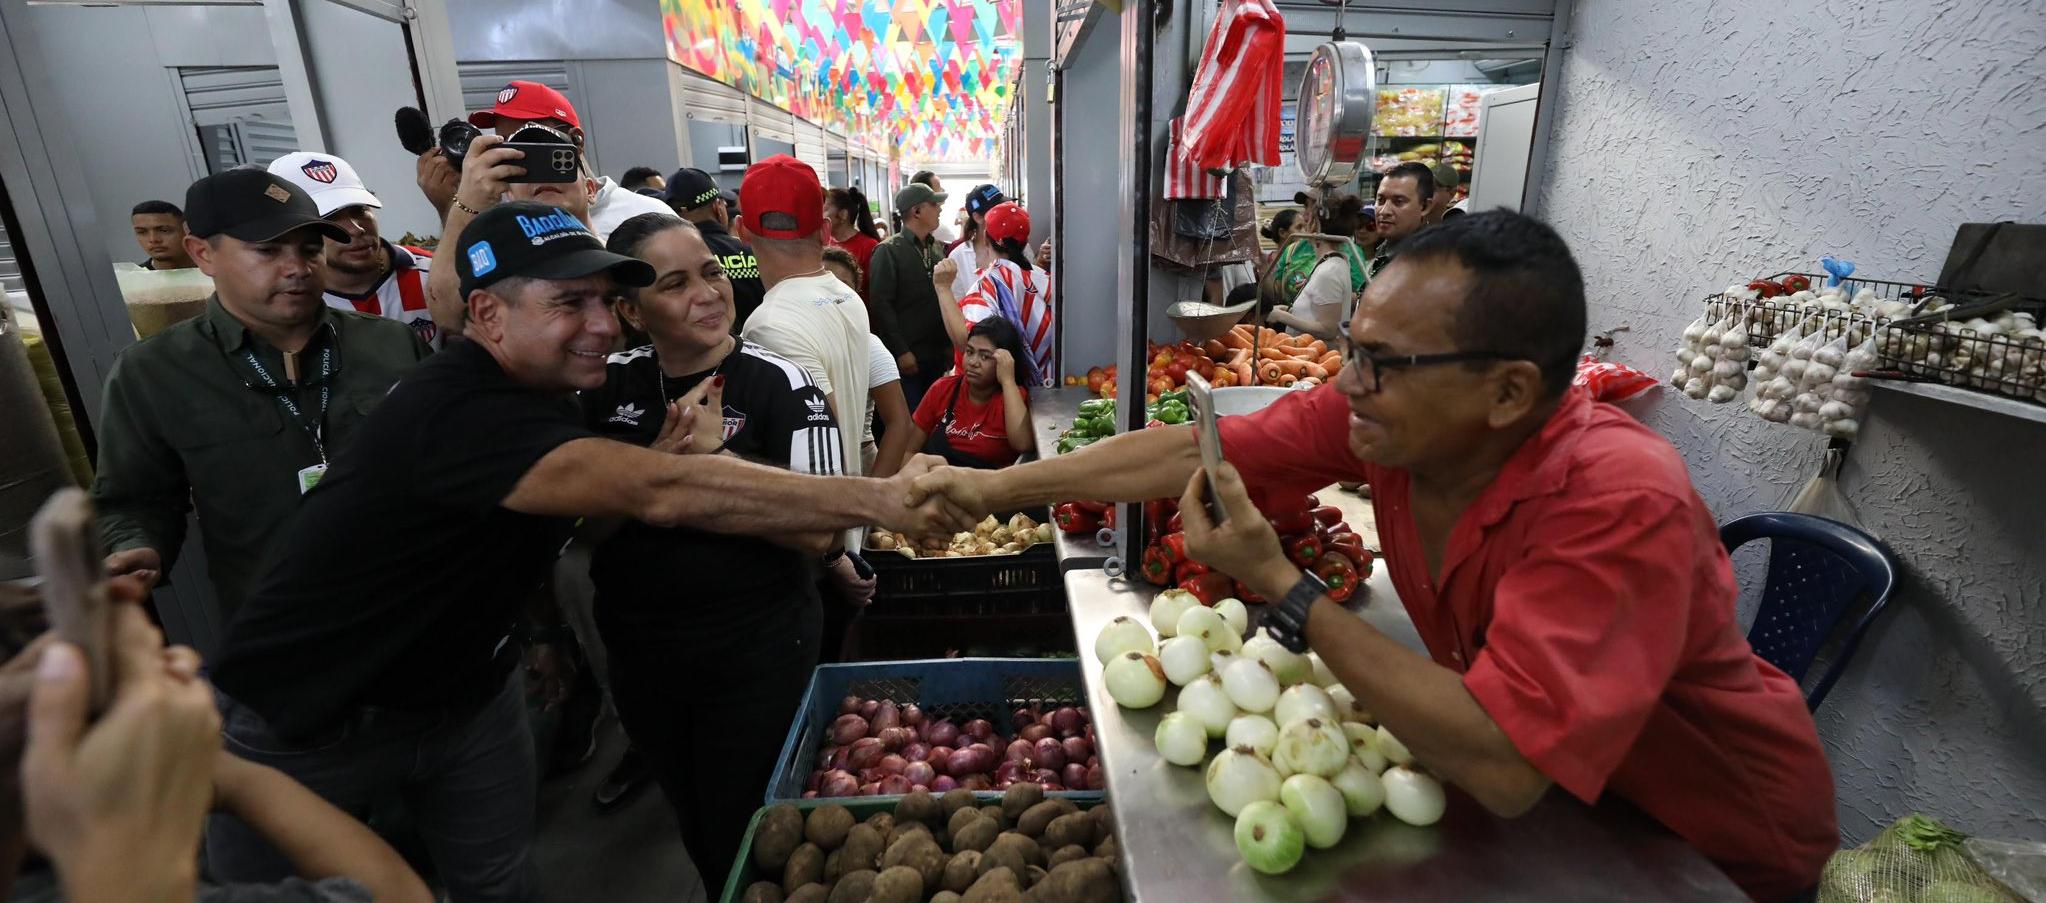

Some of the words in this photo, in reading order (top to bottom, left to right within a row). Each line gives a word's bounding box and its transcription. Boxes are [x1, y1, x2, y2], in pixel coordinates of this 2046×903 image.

[714, 250, 758, 269] LICÍA
[278, 395, 301, 416] POLIC
[608, 415, 639, 426] adidas
[807, 412, 830, 421] adidas
